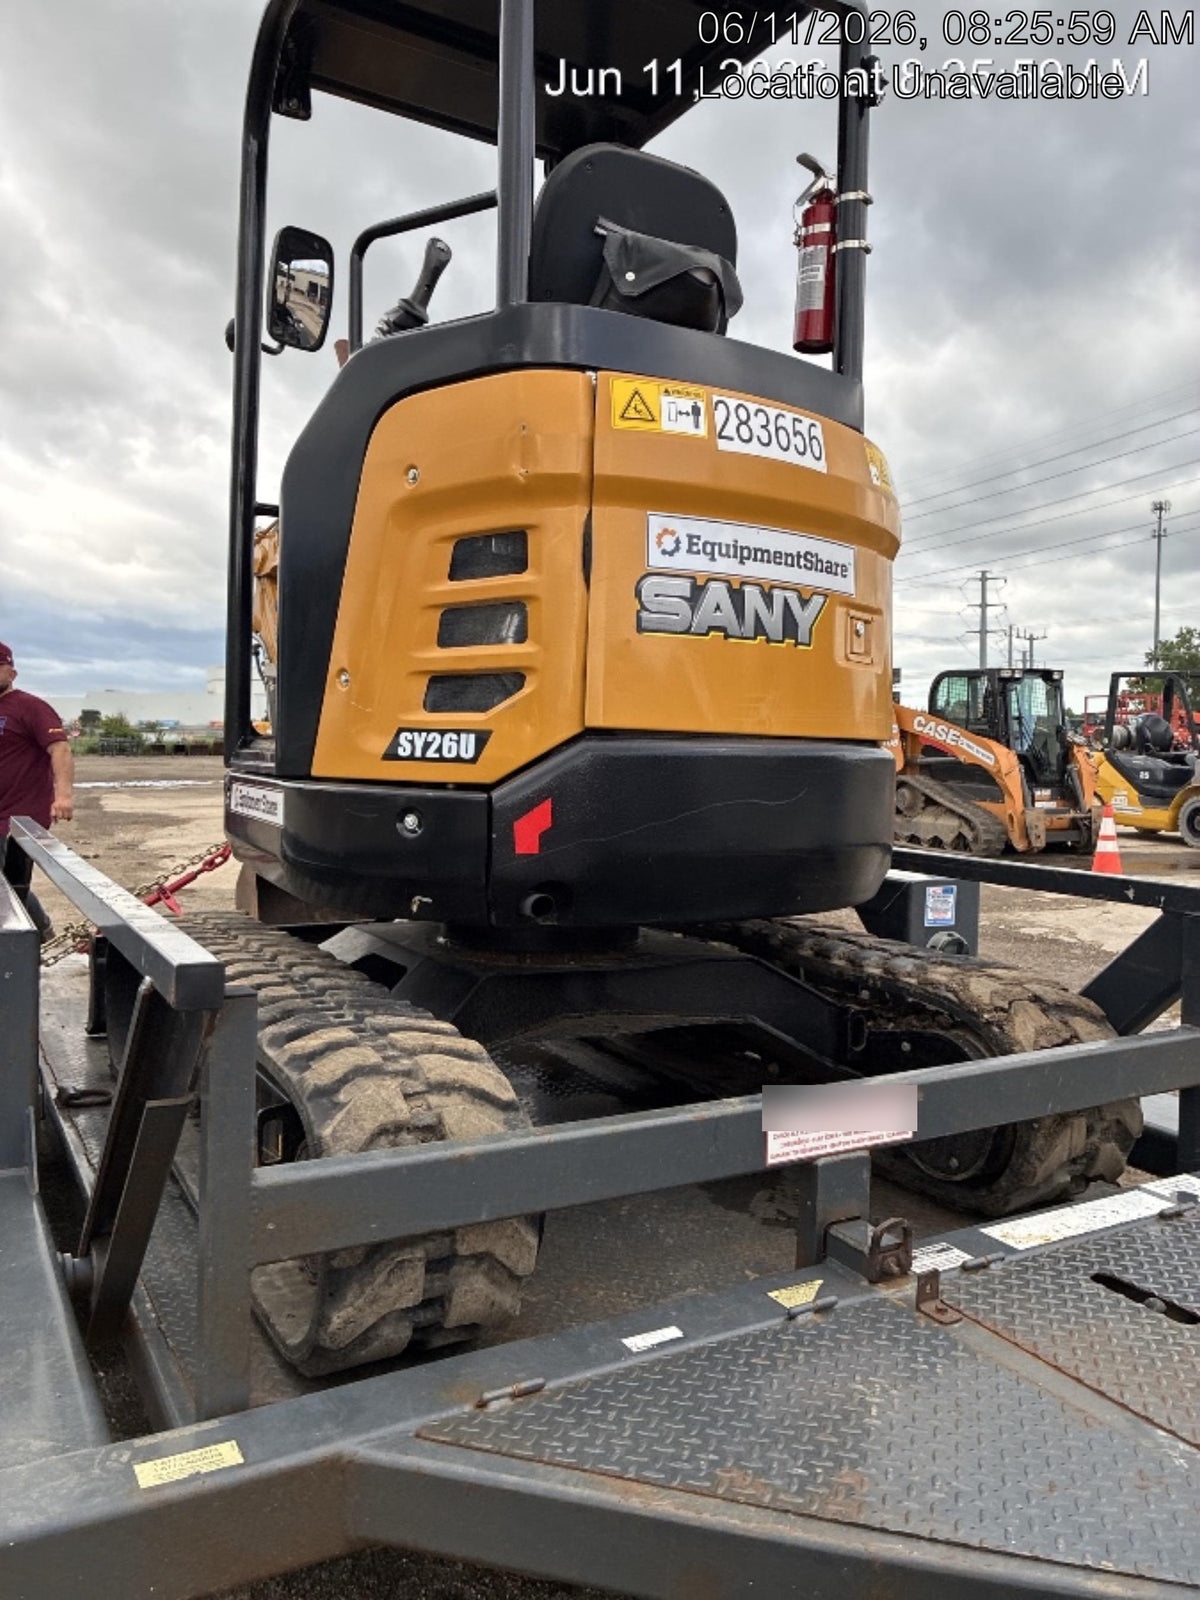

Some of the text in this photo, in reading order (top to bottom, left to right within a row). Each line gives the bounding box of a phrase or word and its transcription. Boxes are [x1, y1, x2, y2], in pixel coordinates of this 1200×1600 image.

[714, 400, 822, 461] 283656
[686, 533, 848, 578] EquipmentShare
[636, 573, 828, 647] SANY
[397, 732, 476, 759] SY26U
[913, 715, 960, 745] CASE
